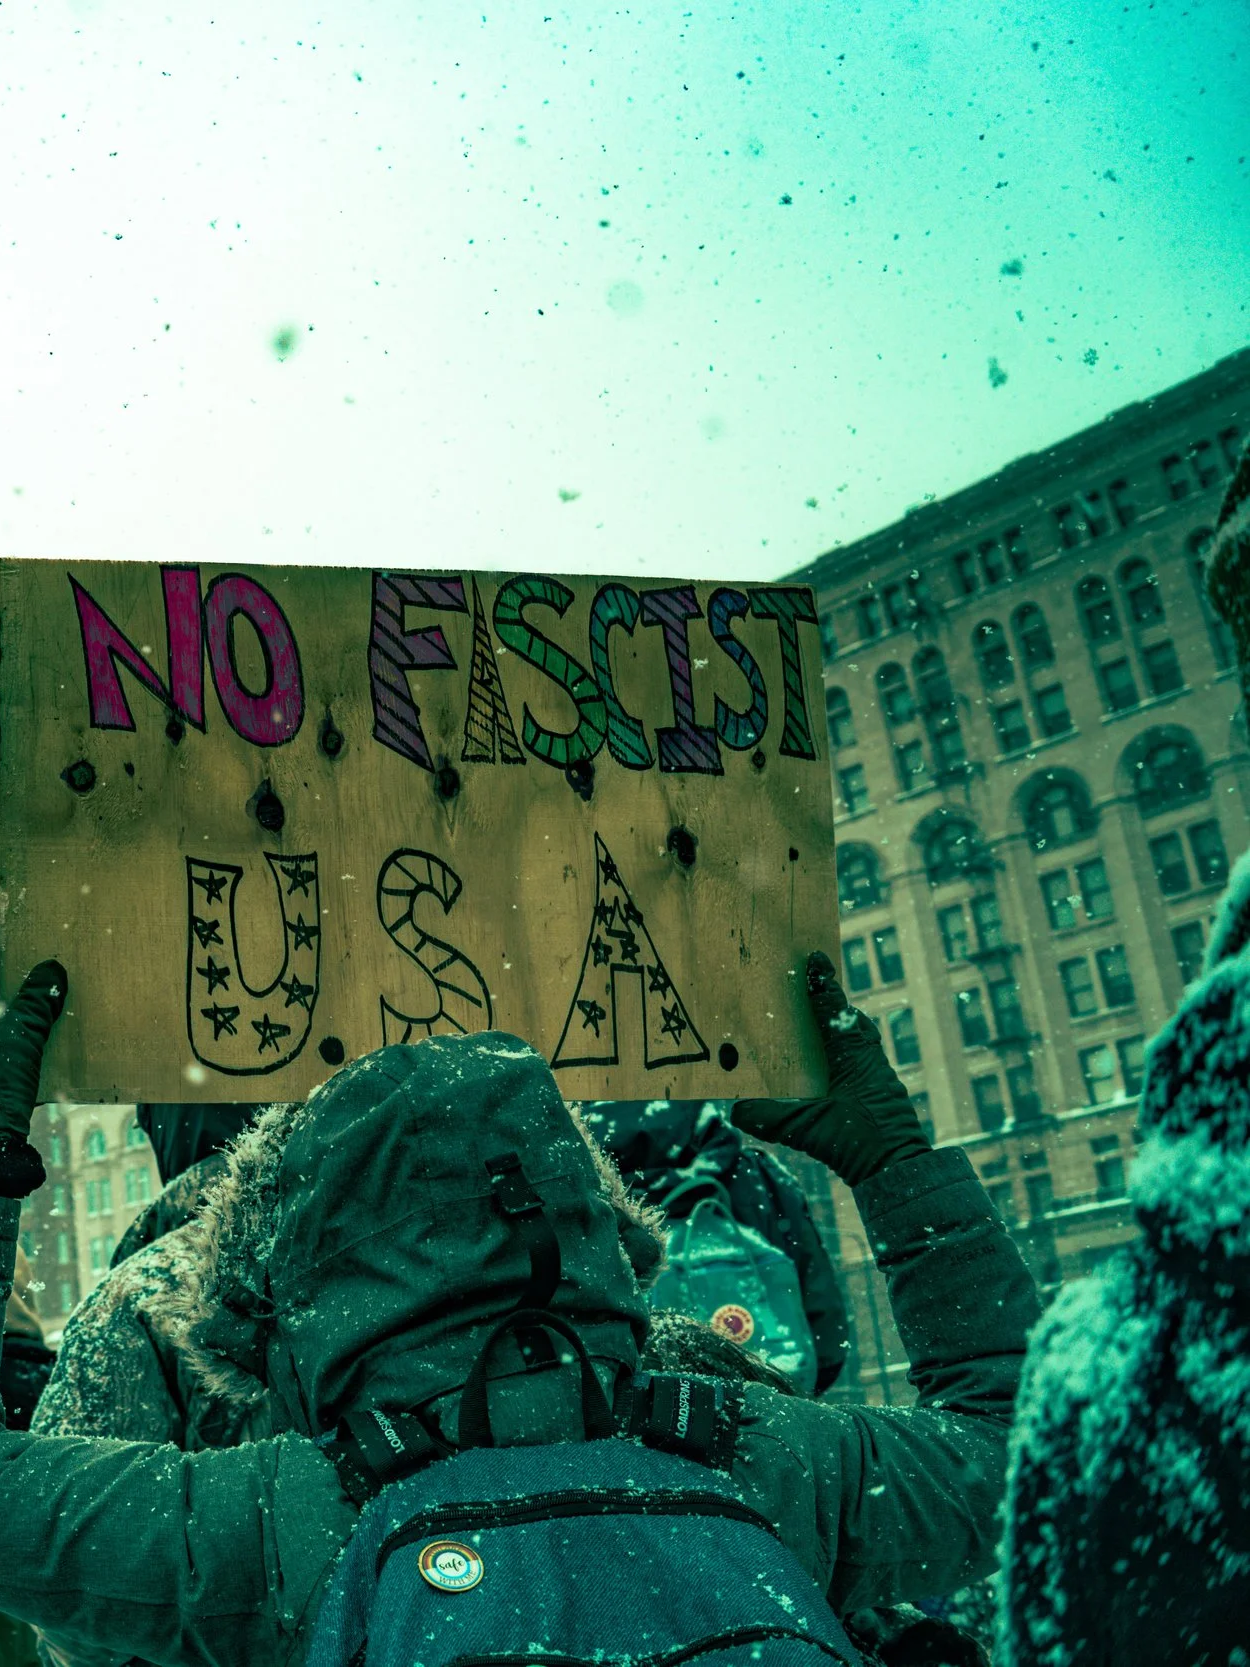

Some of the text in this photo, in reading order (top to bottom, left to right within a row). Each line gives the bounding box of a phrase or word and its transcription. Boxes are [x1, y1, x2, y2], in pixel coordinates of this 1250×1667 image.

[67, 563, 820, 777] NO FASCIST
[367, 1407, 406, 1454] LOADSPRIN
[438, 1558, 465, 1572] safe
[439, 1570, 478, 1586] WITH ME
